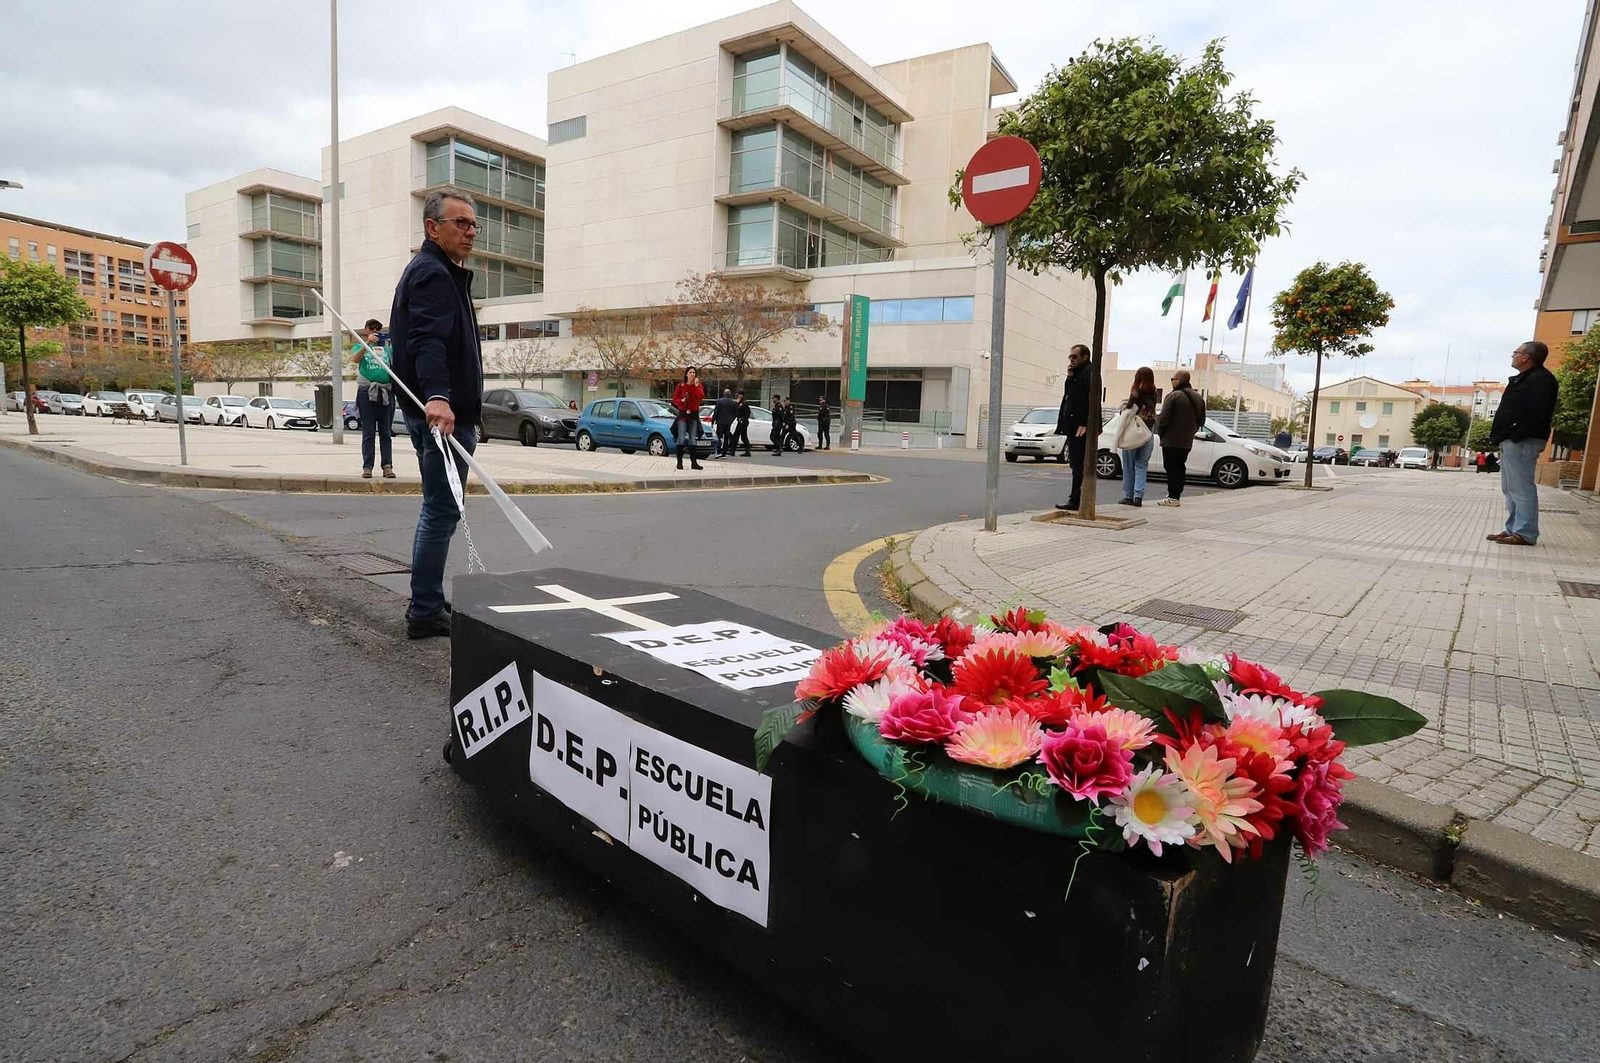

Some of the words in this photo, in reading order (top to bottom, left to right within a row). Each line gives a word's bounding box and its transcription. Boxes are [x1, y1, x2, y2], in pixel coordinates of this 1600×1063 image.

[855, 339, 861, 349] DE
[628, 629, 760, 649] D.E.P.
[682, 645, 812, 668] ESCUELA
[718, 659, 815, 682] PÚBLIC
[457, 680, 526, 749] R.I.P.
[536, 712, 628, 801] D.E.P.
[635, 746, 766, 832] ESCUELA
[638, 803, 760, 892] PÚBLICA
